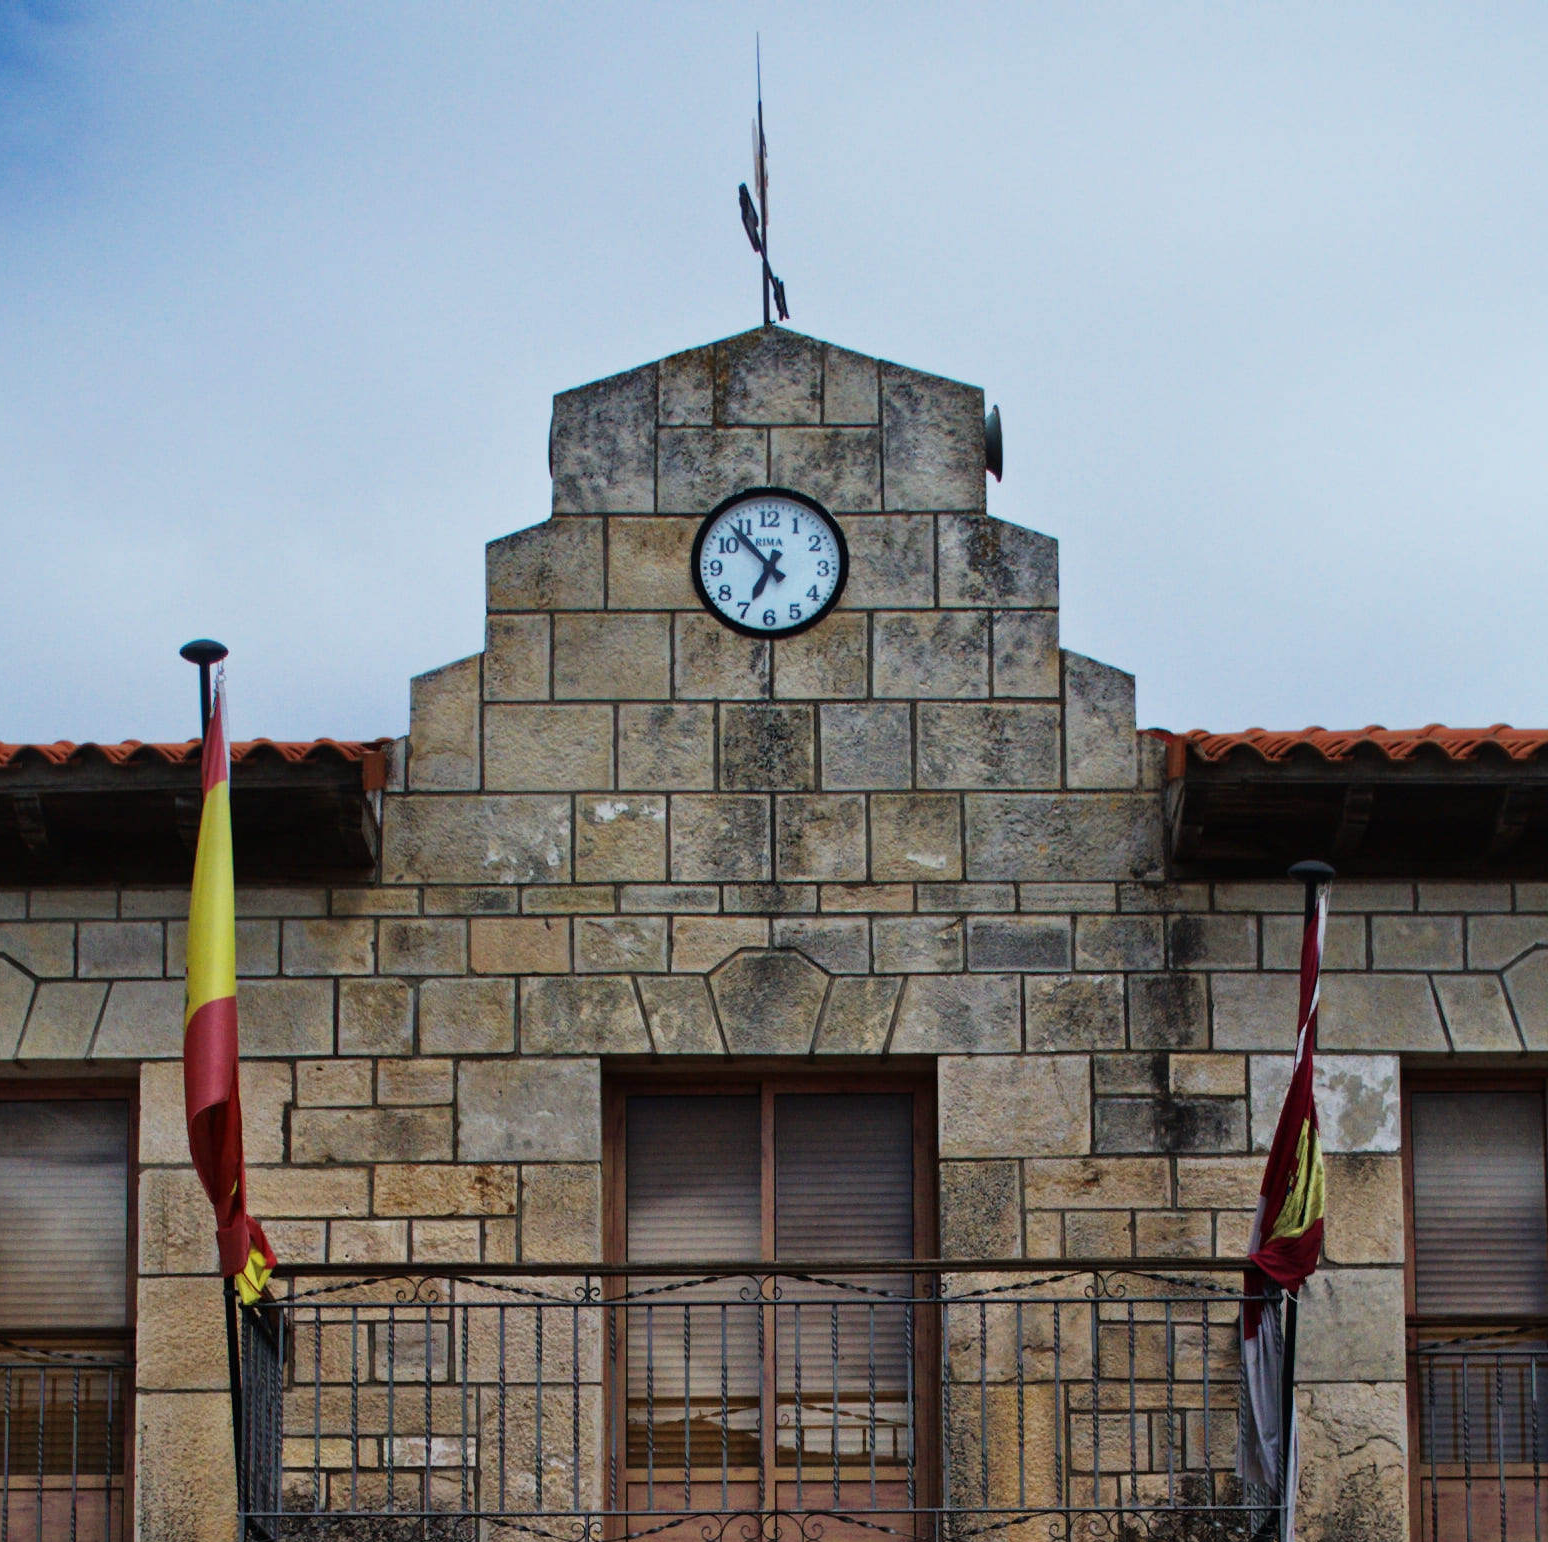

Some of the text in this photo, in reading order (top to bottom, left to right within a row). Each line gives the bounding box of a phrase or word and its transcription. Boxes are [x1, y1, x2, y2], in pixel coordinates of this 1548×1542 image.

[738, 519, 753, 536] 11
[759, 510, 781, 528] 12
[792, 518, 800, 534] 1
[718, 537, 740, 554] 10
[755, 538, 783, 547] RIMA
[808, 535, 822, 552] 2
[709, 560, 723, 577] 9
[817, 560, 830, 577] 3
[718, 585, 732, 601] 8
[806, 585, 820, 602] 4
[737, 602, 751, 619] 7
[762, 609, 776, 626] 6
[789, 603, 802, 620] 5
